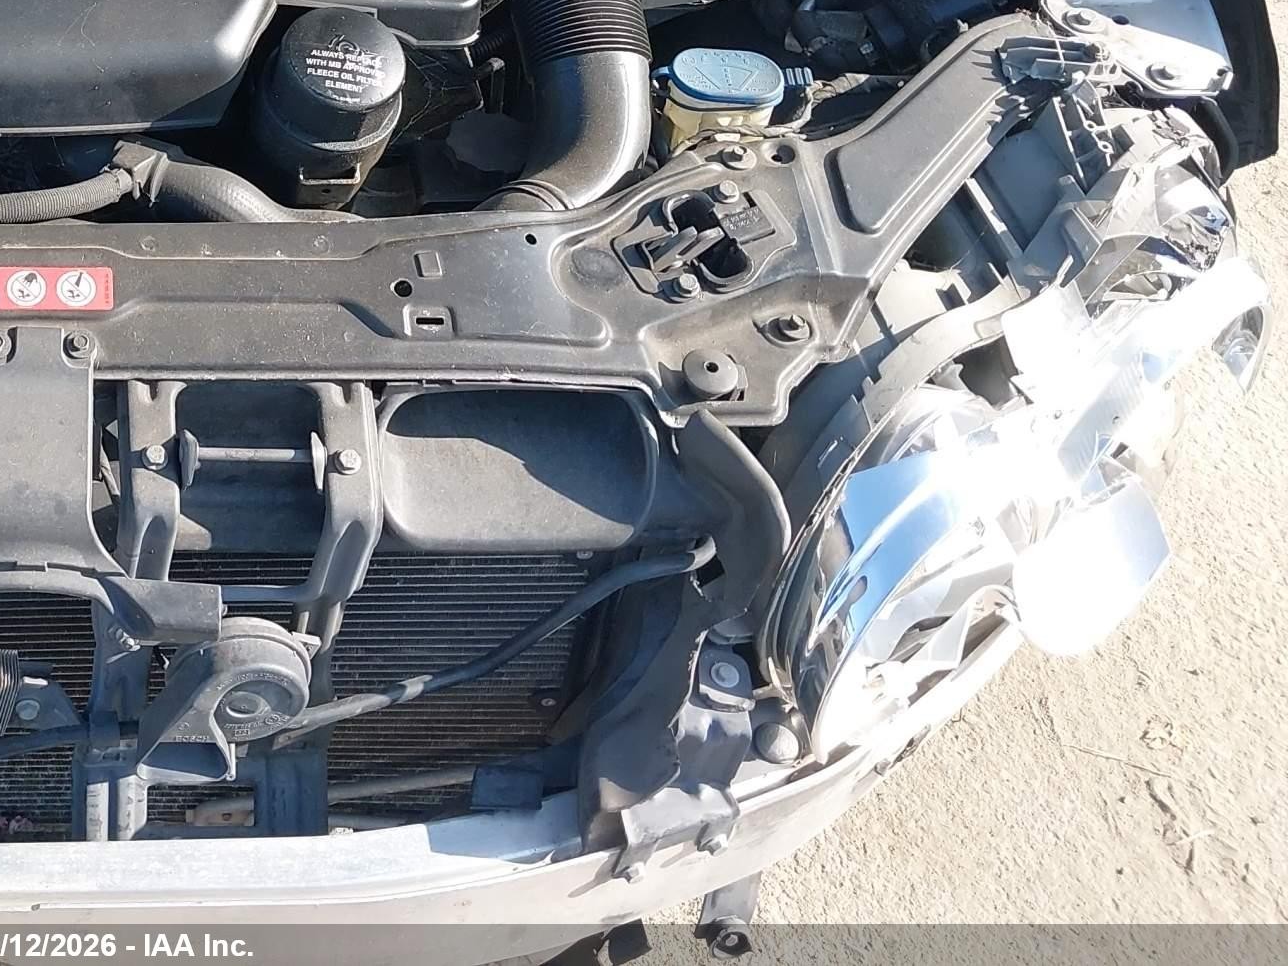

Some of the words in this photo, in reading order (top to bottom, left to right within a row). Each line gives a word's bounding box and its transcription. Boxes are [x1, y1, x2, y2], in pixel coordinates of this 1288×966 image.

[311, 49, 345, 60] ALWAYS
[306, 58, 327, 67] WITH
[328, 60, 342, 69] MB
[307, 67, 340, 79] FLEECE
[340, 72, 355, 82] OIL
[325, 79, 363, 93] ELEMENT
